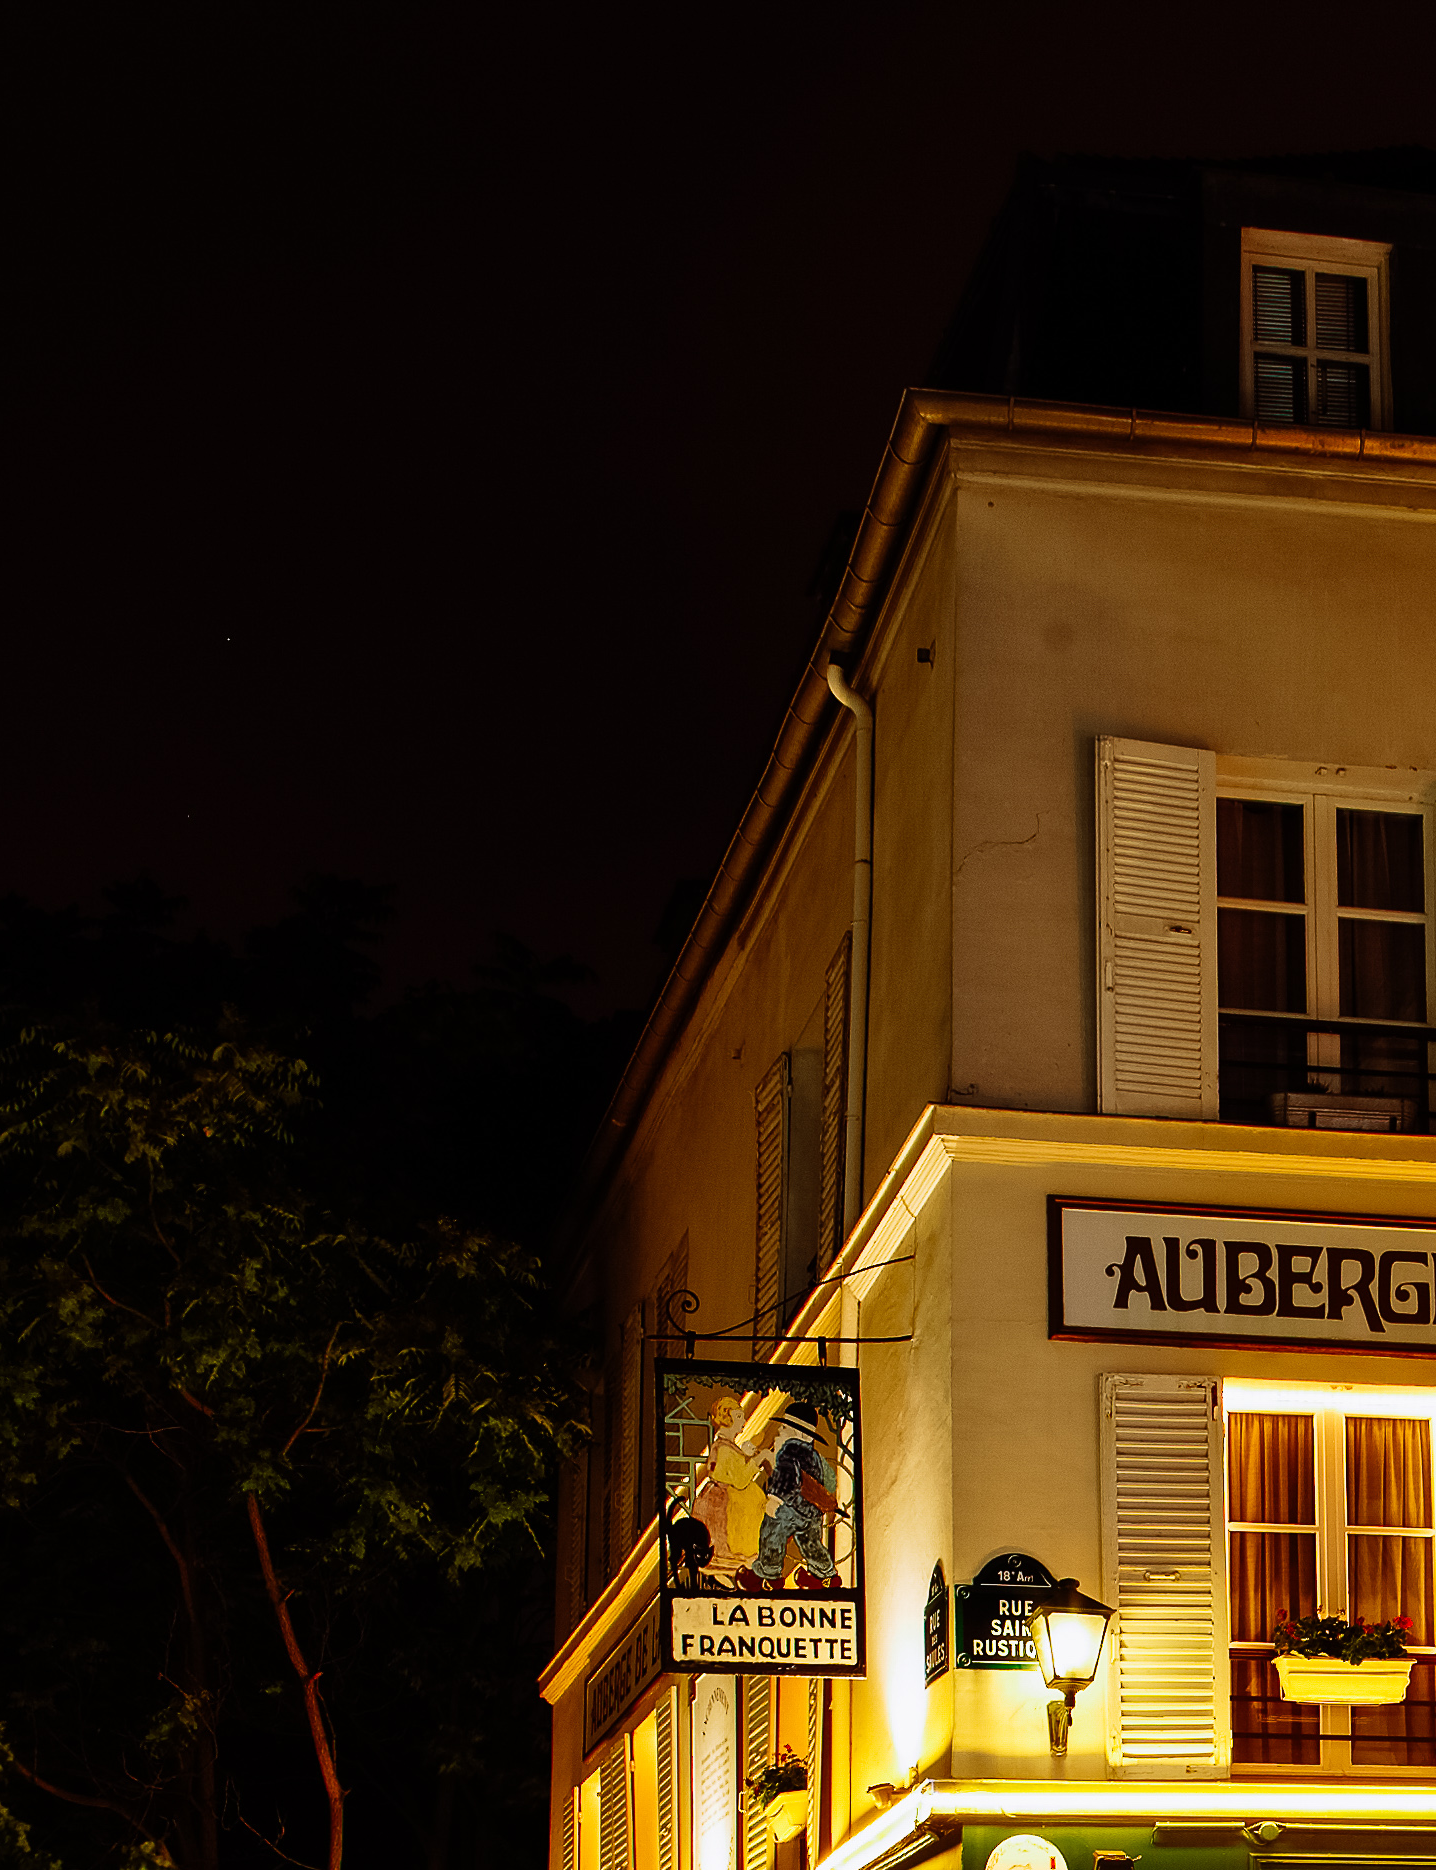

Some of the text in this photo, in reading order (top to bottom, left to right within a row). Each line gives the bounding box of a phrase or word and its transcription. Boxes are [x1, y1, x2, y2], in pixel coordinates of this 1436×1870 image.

[712, 1603, 853, 1630] LA BONNE
[999, 1600, 1033, 1616] RUE
[929, 1609, 940, 1635] RUE
[991, 1619, 1032, 1637] SAIN
[681, 1633, 853, 1660] FRANQUETTE
[926, 1644, 945, 1673] SAULES
[973, 1639, 1038, 1658] RUSTIQ
[591, 1645, 632, 1736] AUBERGE
